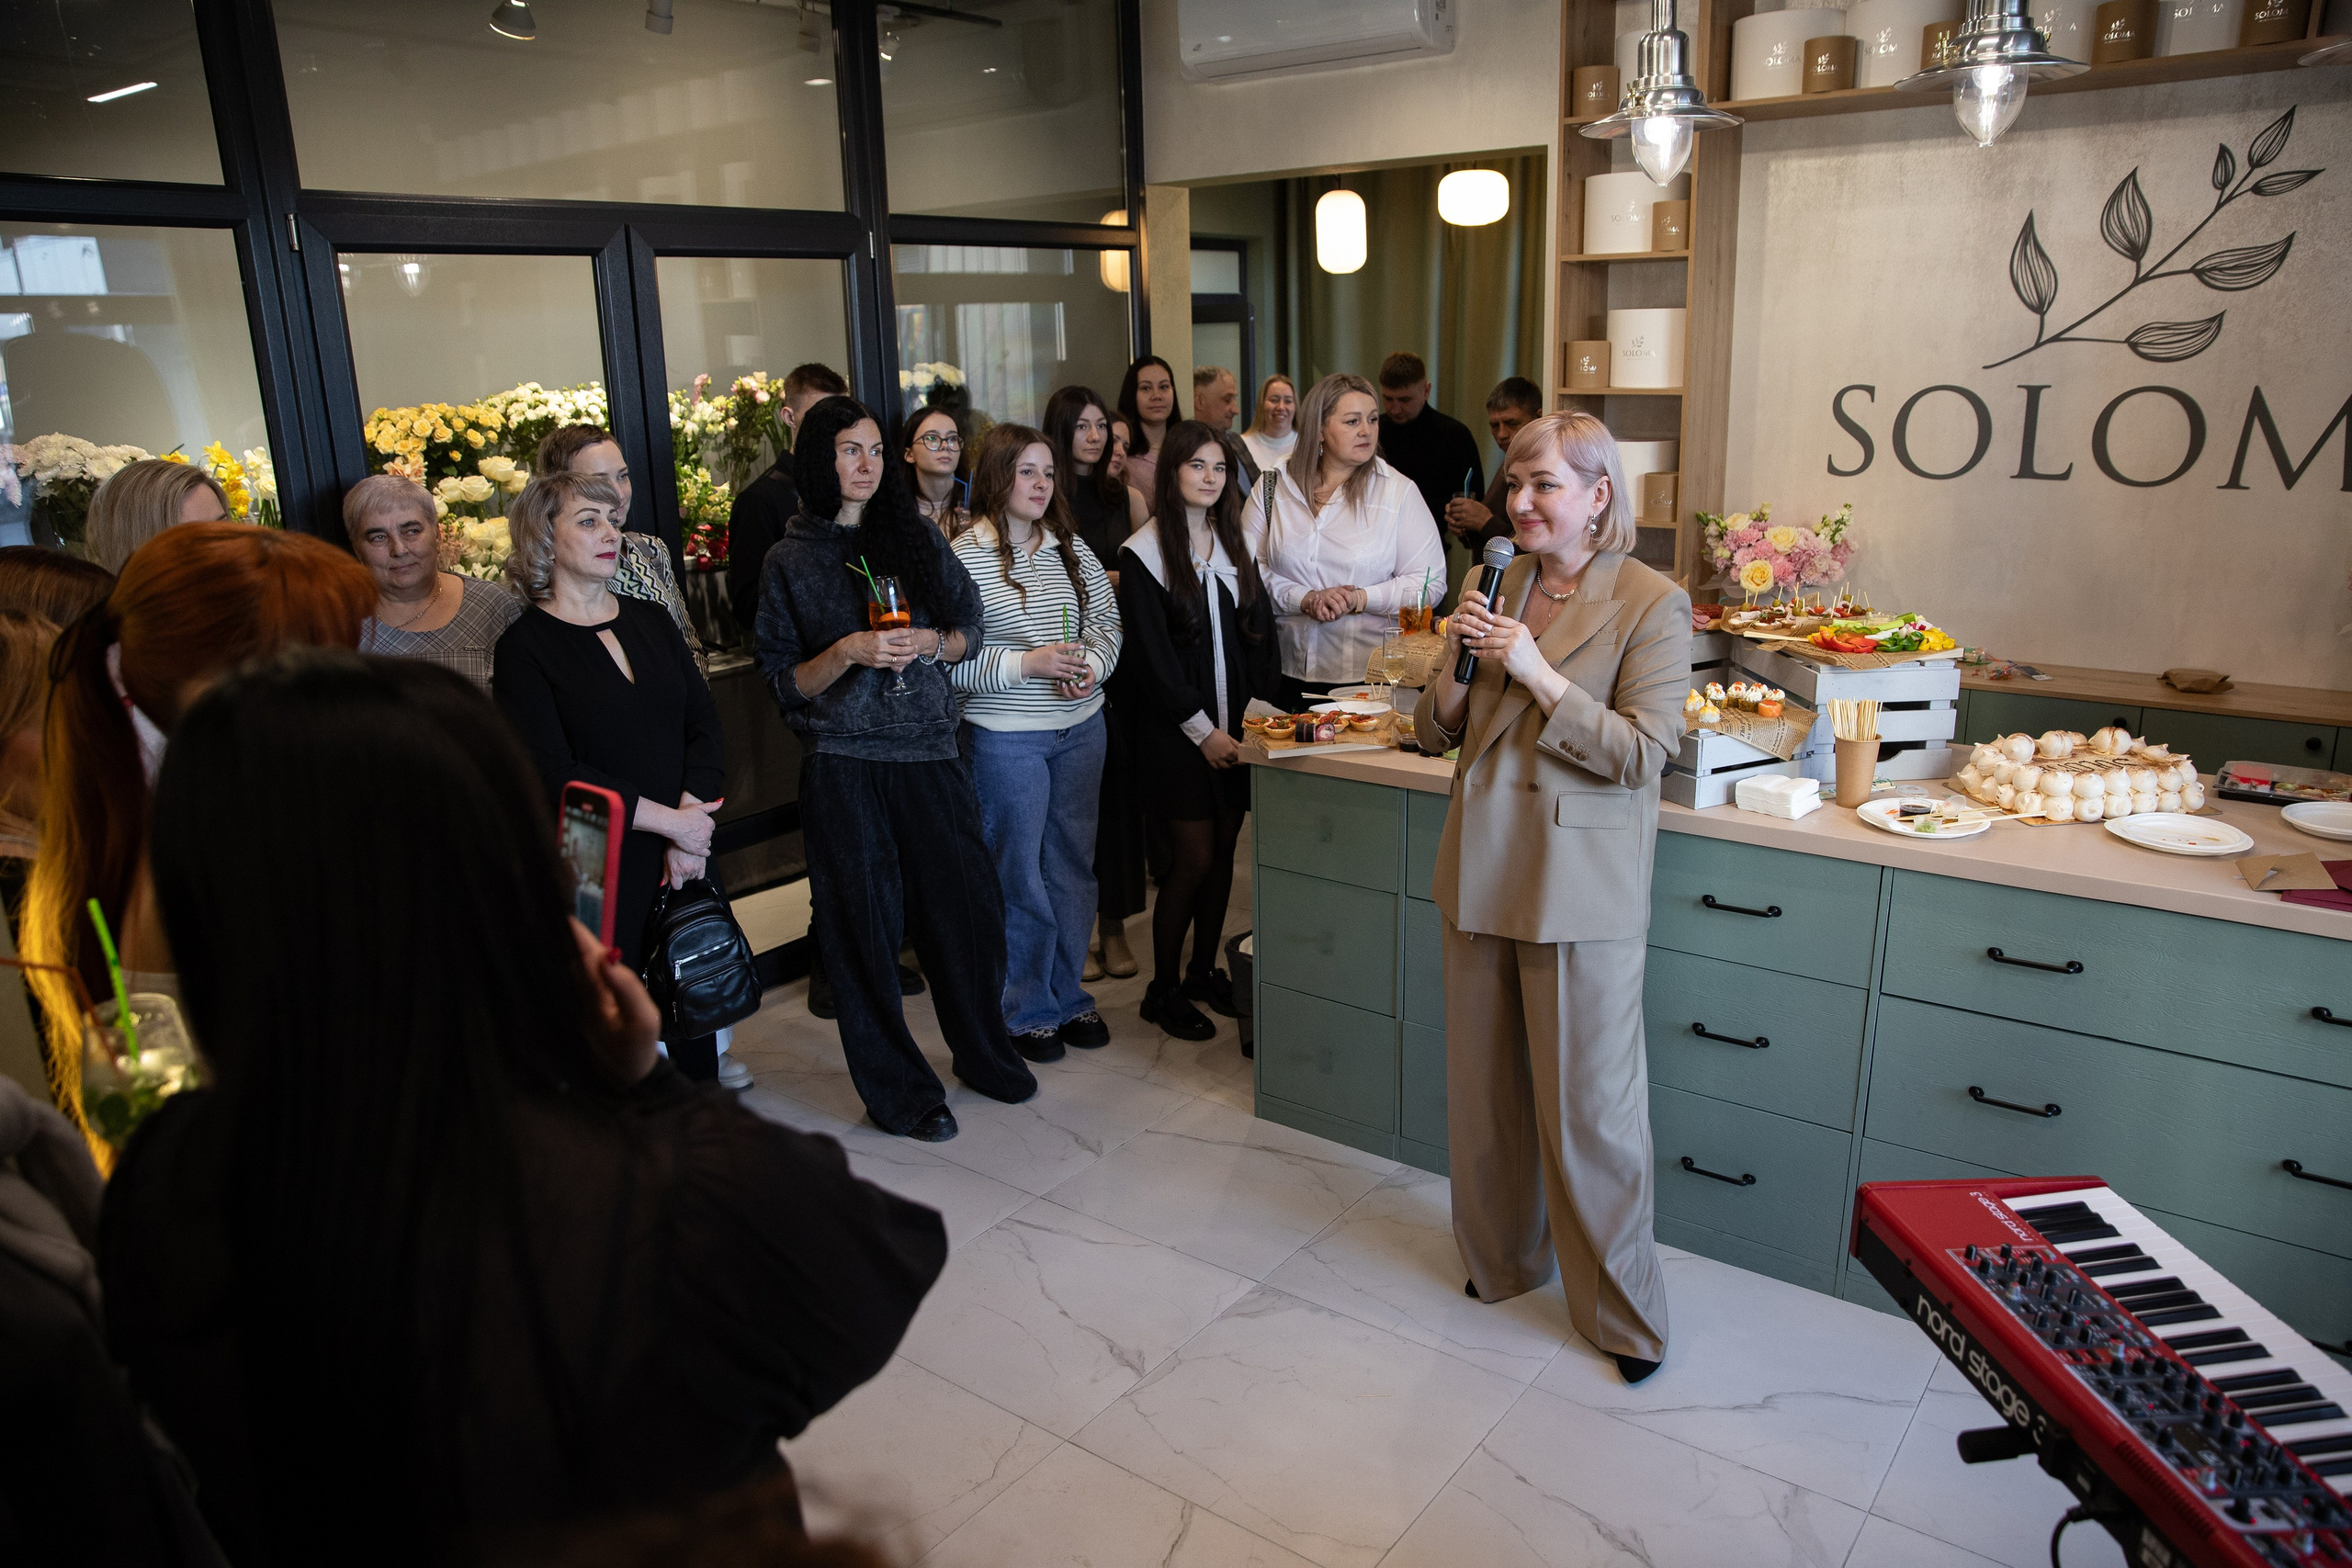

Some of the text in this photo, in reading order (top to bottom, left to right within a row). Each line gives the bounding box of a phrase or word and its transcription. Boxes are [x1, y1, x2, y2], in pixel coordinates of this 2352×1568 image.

[2254, 8, 2289, 20] SOLOM
[2102, 30, 2136, 41] OLOMA
[1811, 63, 1838, 73] OLOMA
[1977, 1196, 2009, 1223] stage
[2000, 1220, 2033, 1242] nord
[1917, 1293, 1966, 1361] nord
[1968, 1349, 2030, 1427] stage
